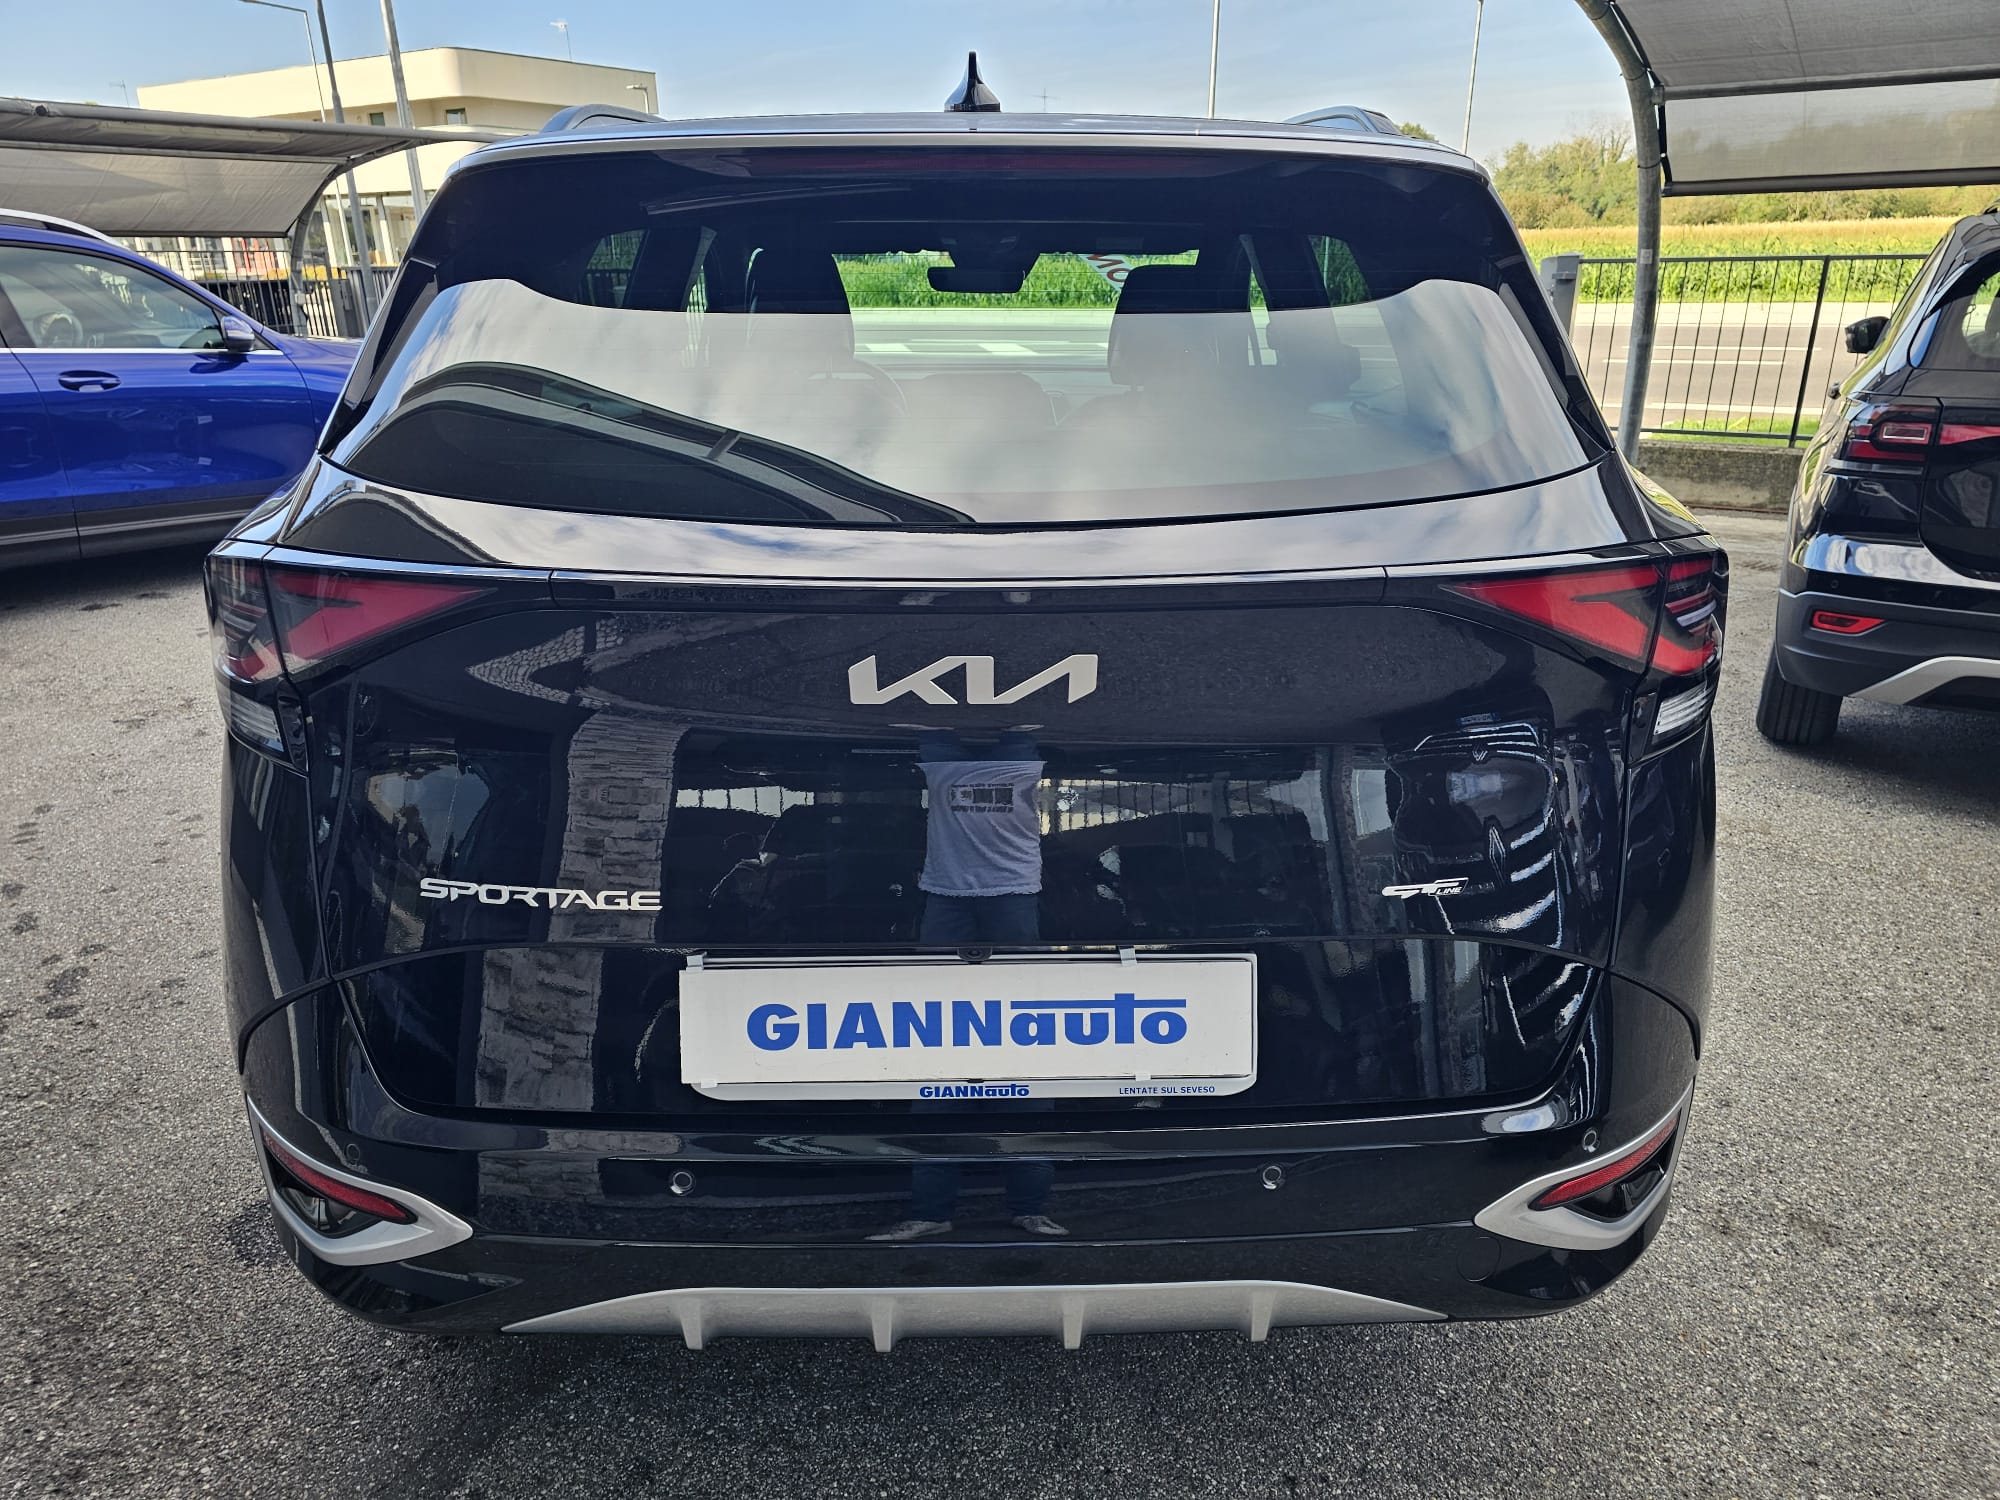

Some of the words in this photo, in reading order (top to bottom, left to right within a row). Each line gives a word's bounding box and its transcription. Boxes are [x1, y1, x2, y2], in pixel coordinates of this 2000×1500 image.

[848, 654, 1099, 705] KIA
[420, 877, 663, 911] SPORTAGE
[746, 992, 1188, 1051] GIANNauto
[919, 1083, 1030, 1098] GIANNauto
[1119, 1086, 1158, 1095] LENTATE
[1160, 1086, 1178, 1094] SUL
[1180, 1085, 1215, 1094] SEVESO
